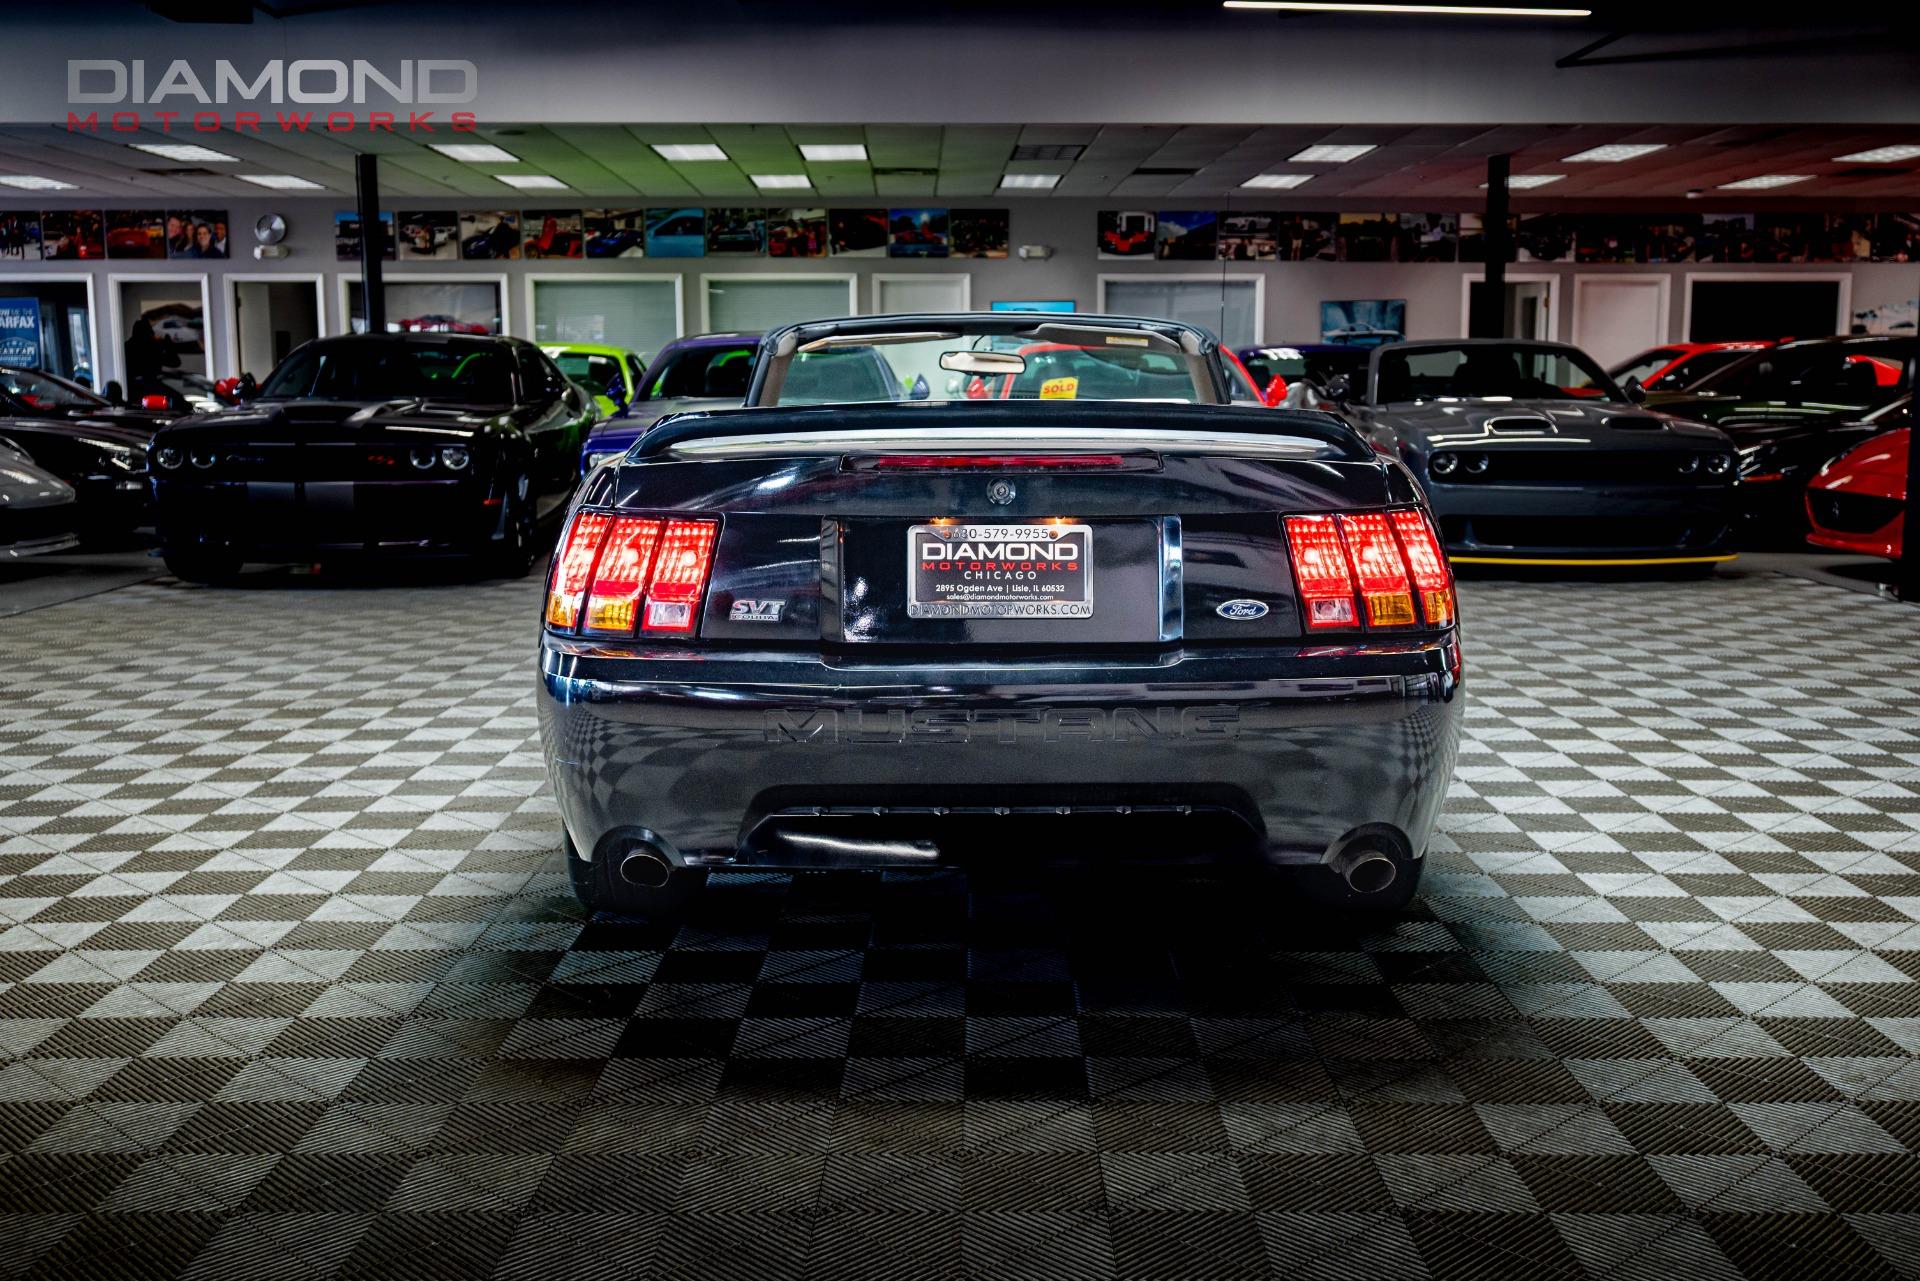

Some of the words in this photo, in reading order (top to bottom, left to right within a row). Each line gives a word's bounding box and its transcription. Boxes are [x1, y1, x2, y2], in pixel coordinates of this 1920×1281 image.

[0, 316, 35, 328] ARFAX
[1043, 382, 1074, 393] SOLD
[952, 528, 1049, 539] 630-579-9955
[922, 543, 1078, 560] DIAMOND
[922, 562, 1078, 570] MOTORWORKS
[964, 571, 1037, 580] CHICAGO
[956, 585, 985, 594] Ogden
[732, 599, 785, 614] SVT
[909, 604, 1091, 616] DIAMONDMOTORWORKS.COM
[1229, 603, 1257, 615] Ford
[763, 705, 1241, 744] MUSTANG
